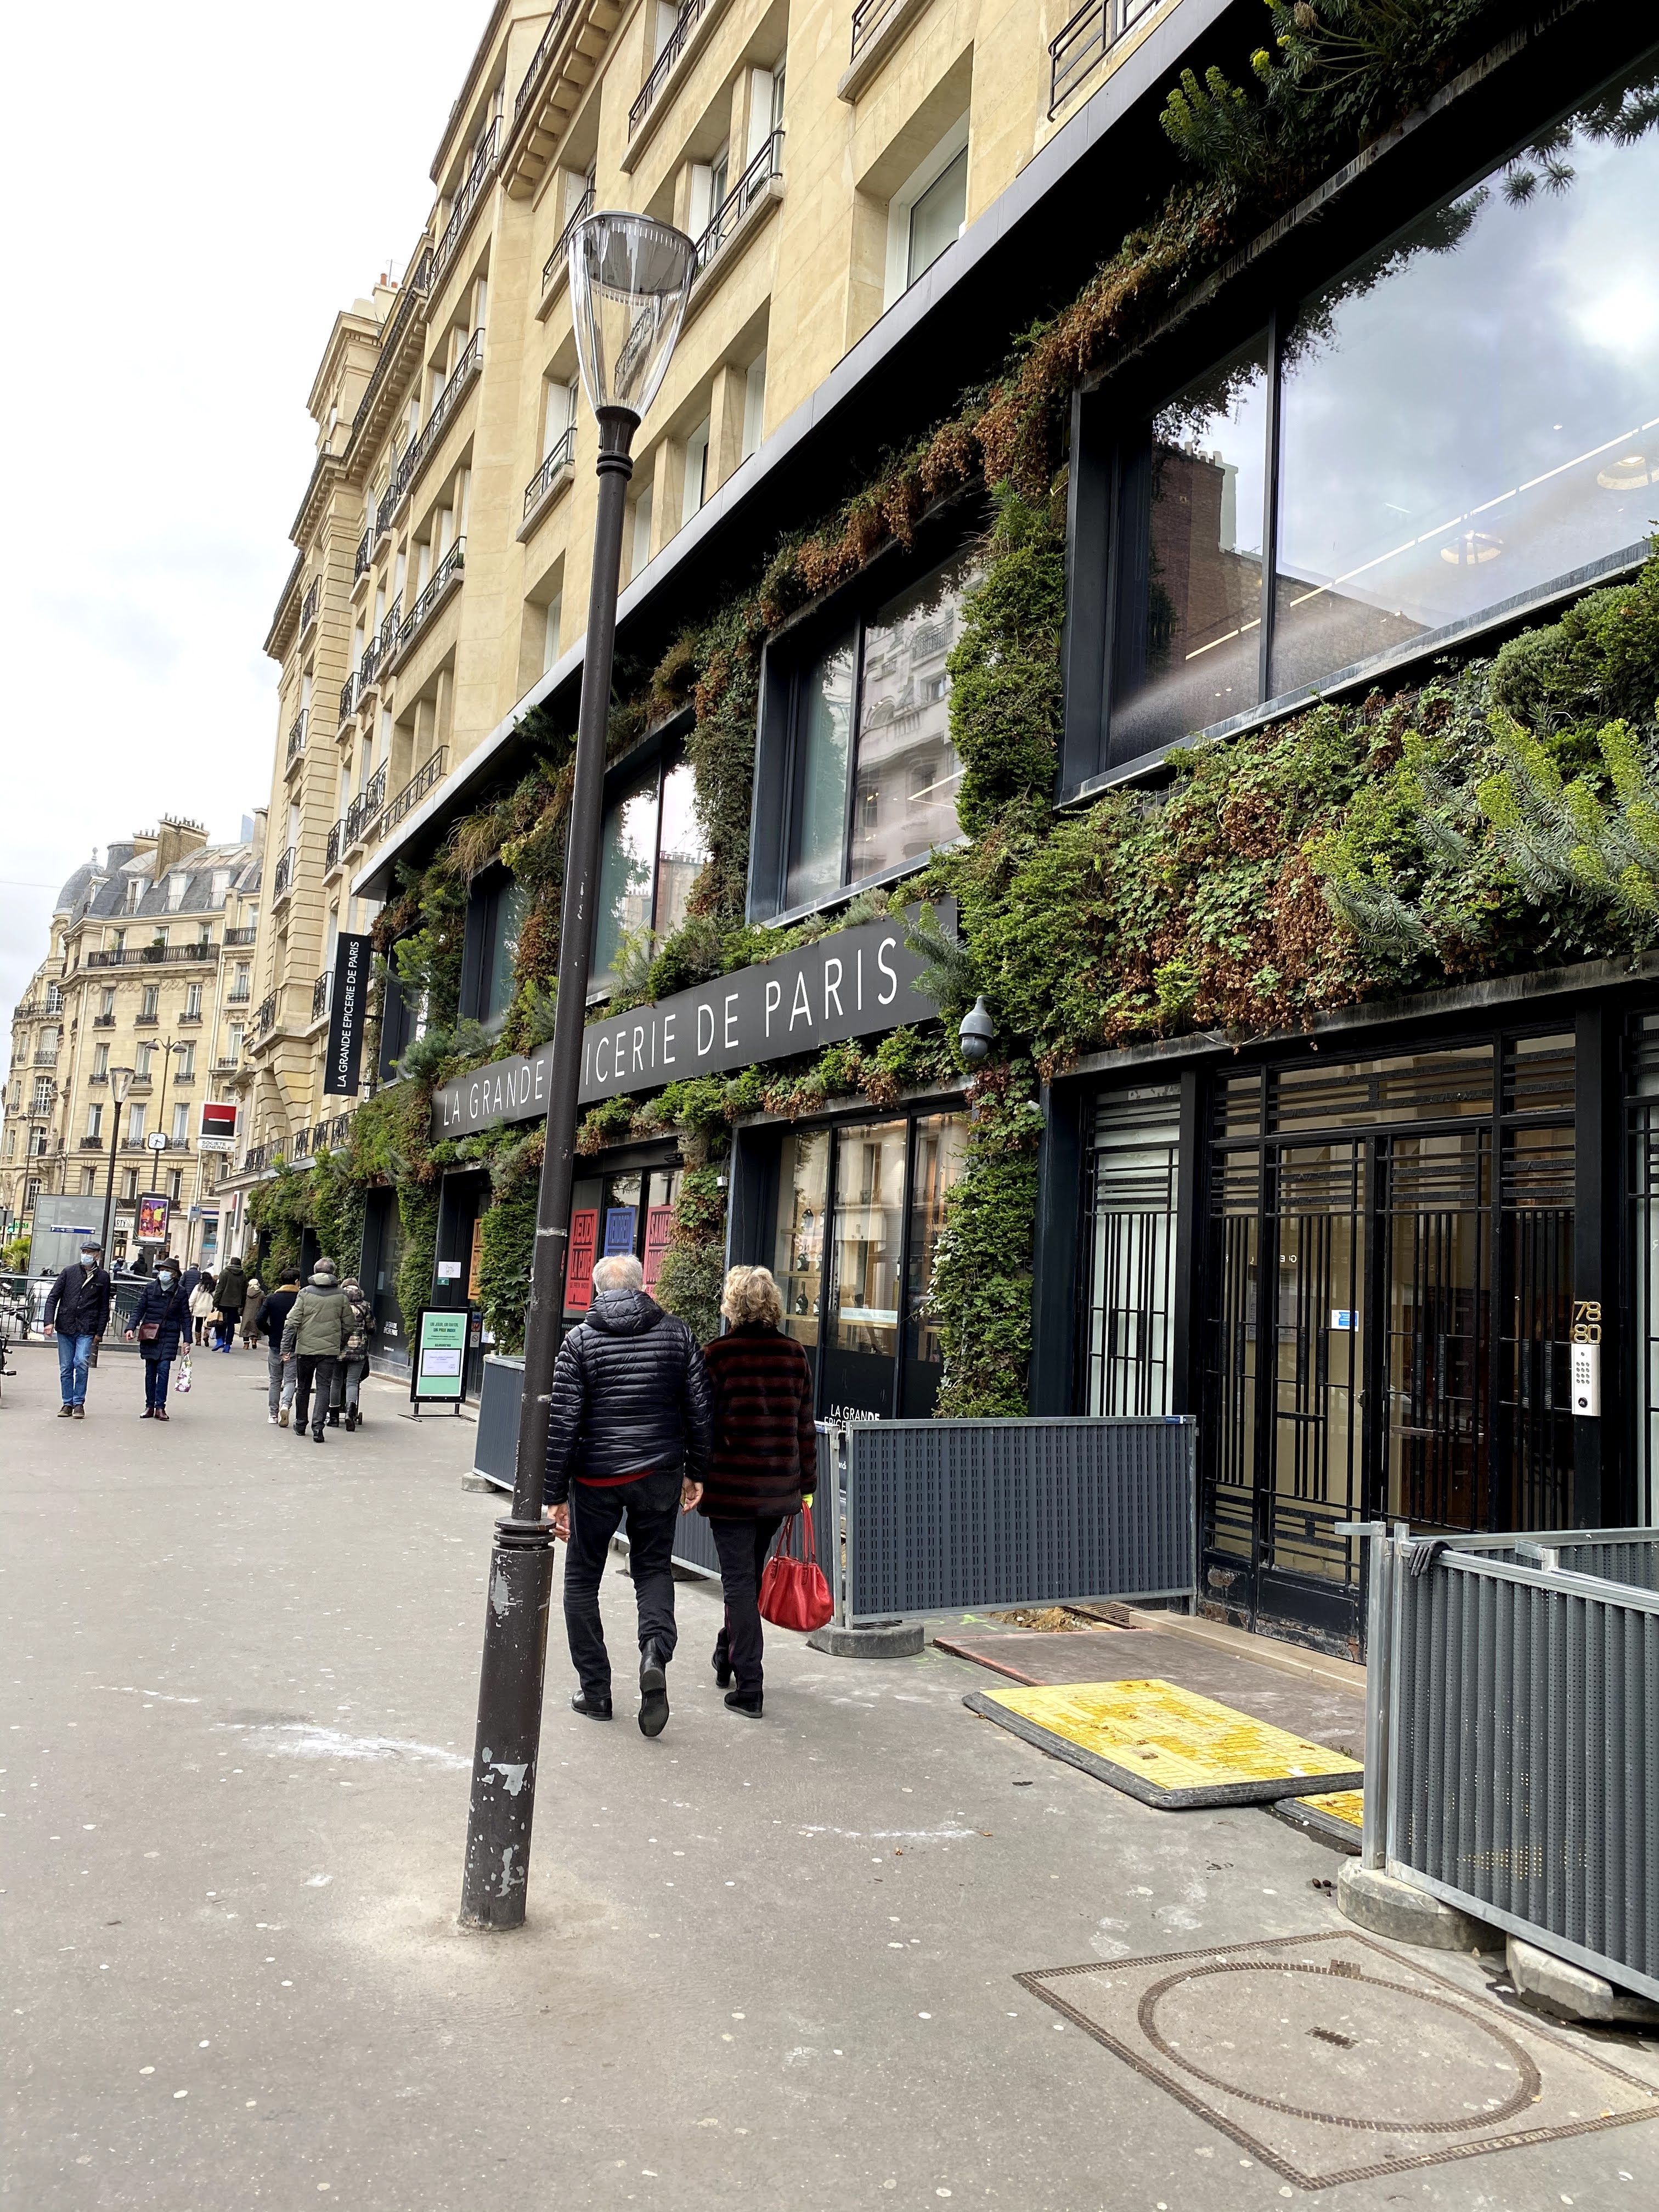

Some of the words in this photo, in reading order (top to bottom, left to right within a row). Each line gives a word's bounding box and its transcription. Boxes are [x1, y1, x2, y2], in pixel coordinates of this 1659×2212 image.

[348, 941, 360, 968] PARIS
[347, 969, 357, 984] DE
[342, 985, 356, 1029] EPICERIE
[442, 1094, 460, 1126] LA
[469, 1059, 544, 1118] GRANDE
[585, 1013, 676, 1086] ICERIE
[696, 993, 740, 1056] DE
[765, 937, 898, 1038] PARIS
[338, 1030, 351, 1074] GRANDE
[337, 1074, 347, 1088] LA
[573, 1215, 595, 1244] JEUDI
[650, 1213, 670, 1244] SAME
[1574, 1300, 1602, 1322] 78
[1573, 1323, 1602, 1344] 80
[824, 1416, 846, 1431] EPICE
[831, 1404, 841, 1418] LA
[843, 1406, 880, 1421] GRANDE
